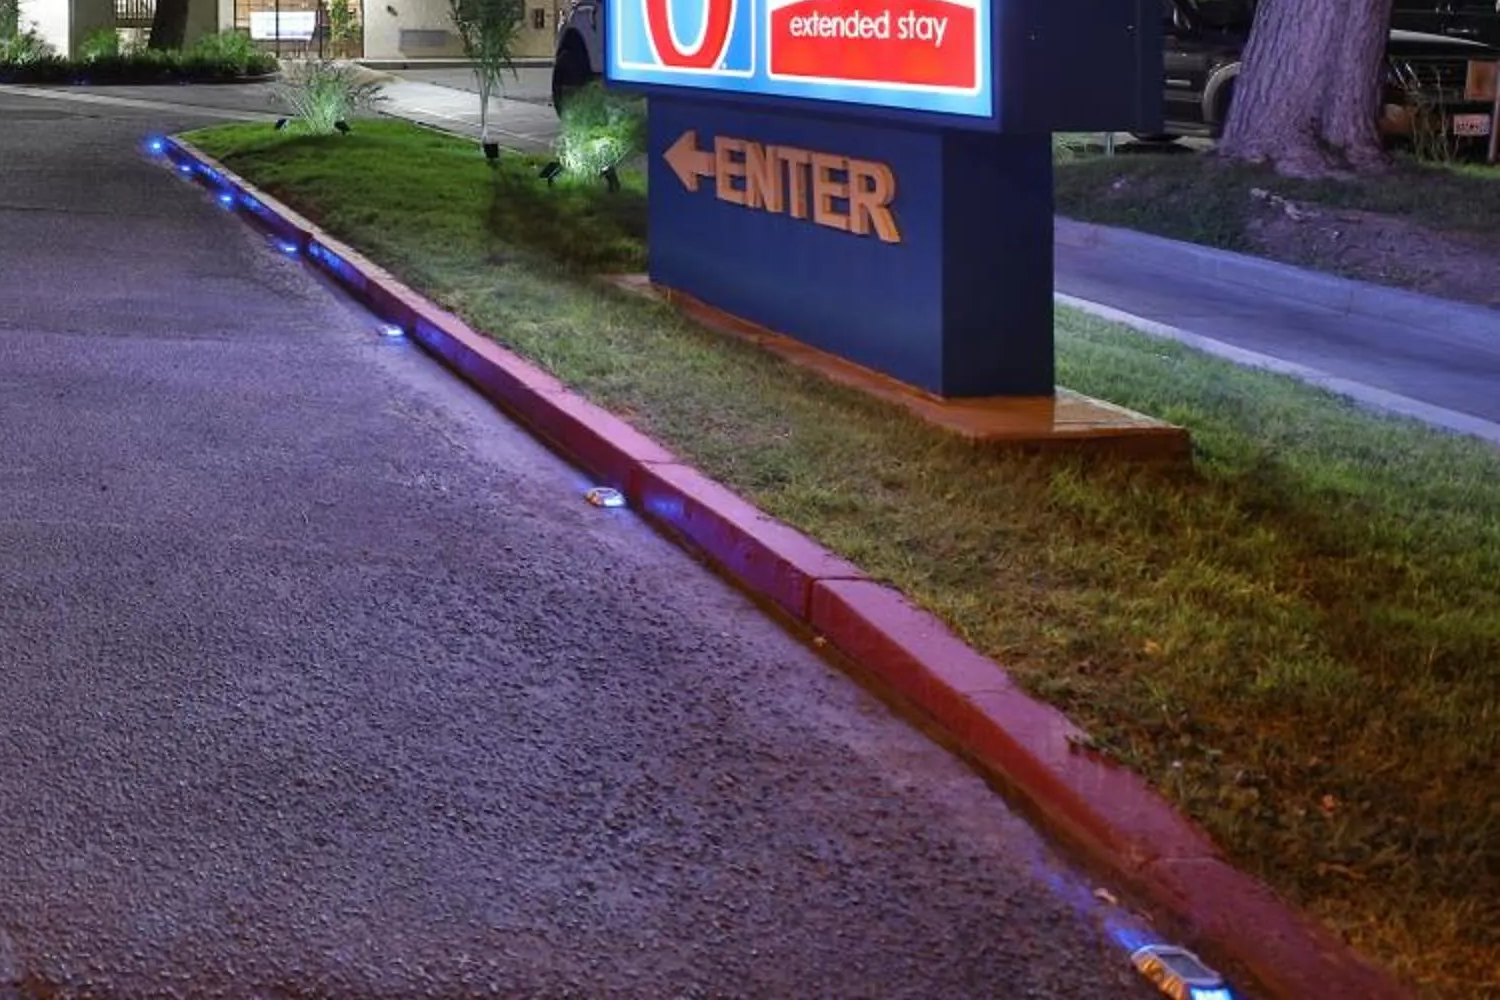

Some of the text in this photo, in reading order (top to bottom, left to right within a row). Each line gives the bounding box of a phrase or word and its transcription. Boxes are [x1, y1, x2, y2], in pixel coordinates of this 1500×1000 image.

[789, 8, 948, 48] extended stay
[714, 135, 900, 243] ENTER
